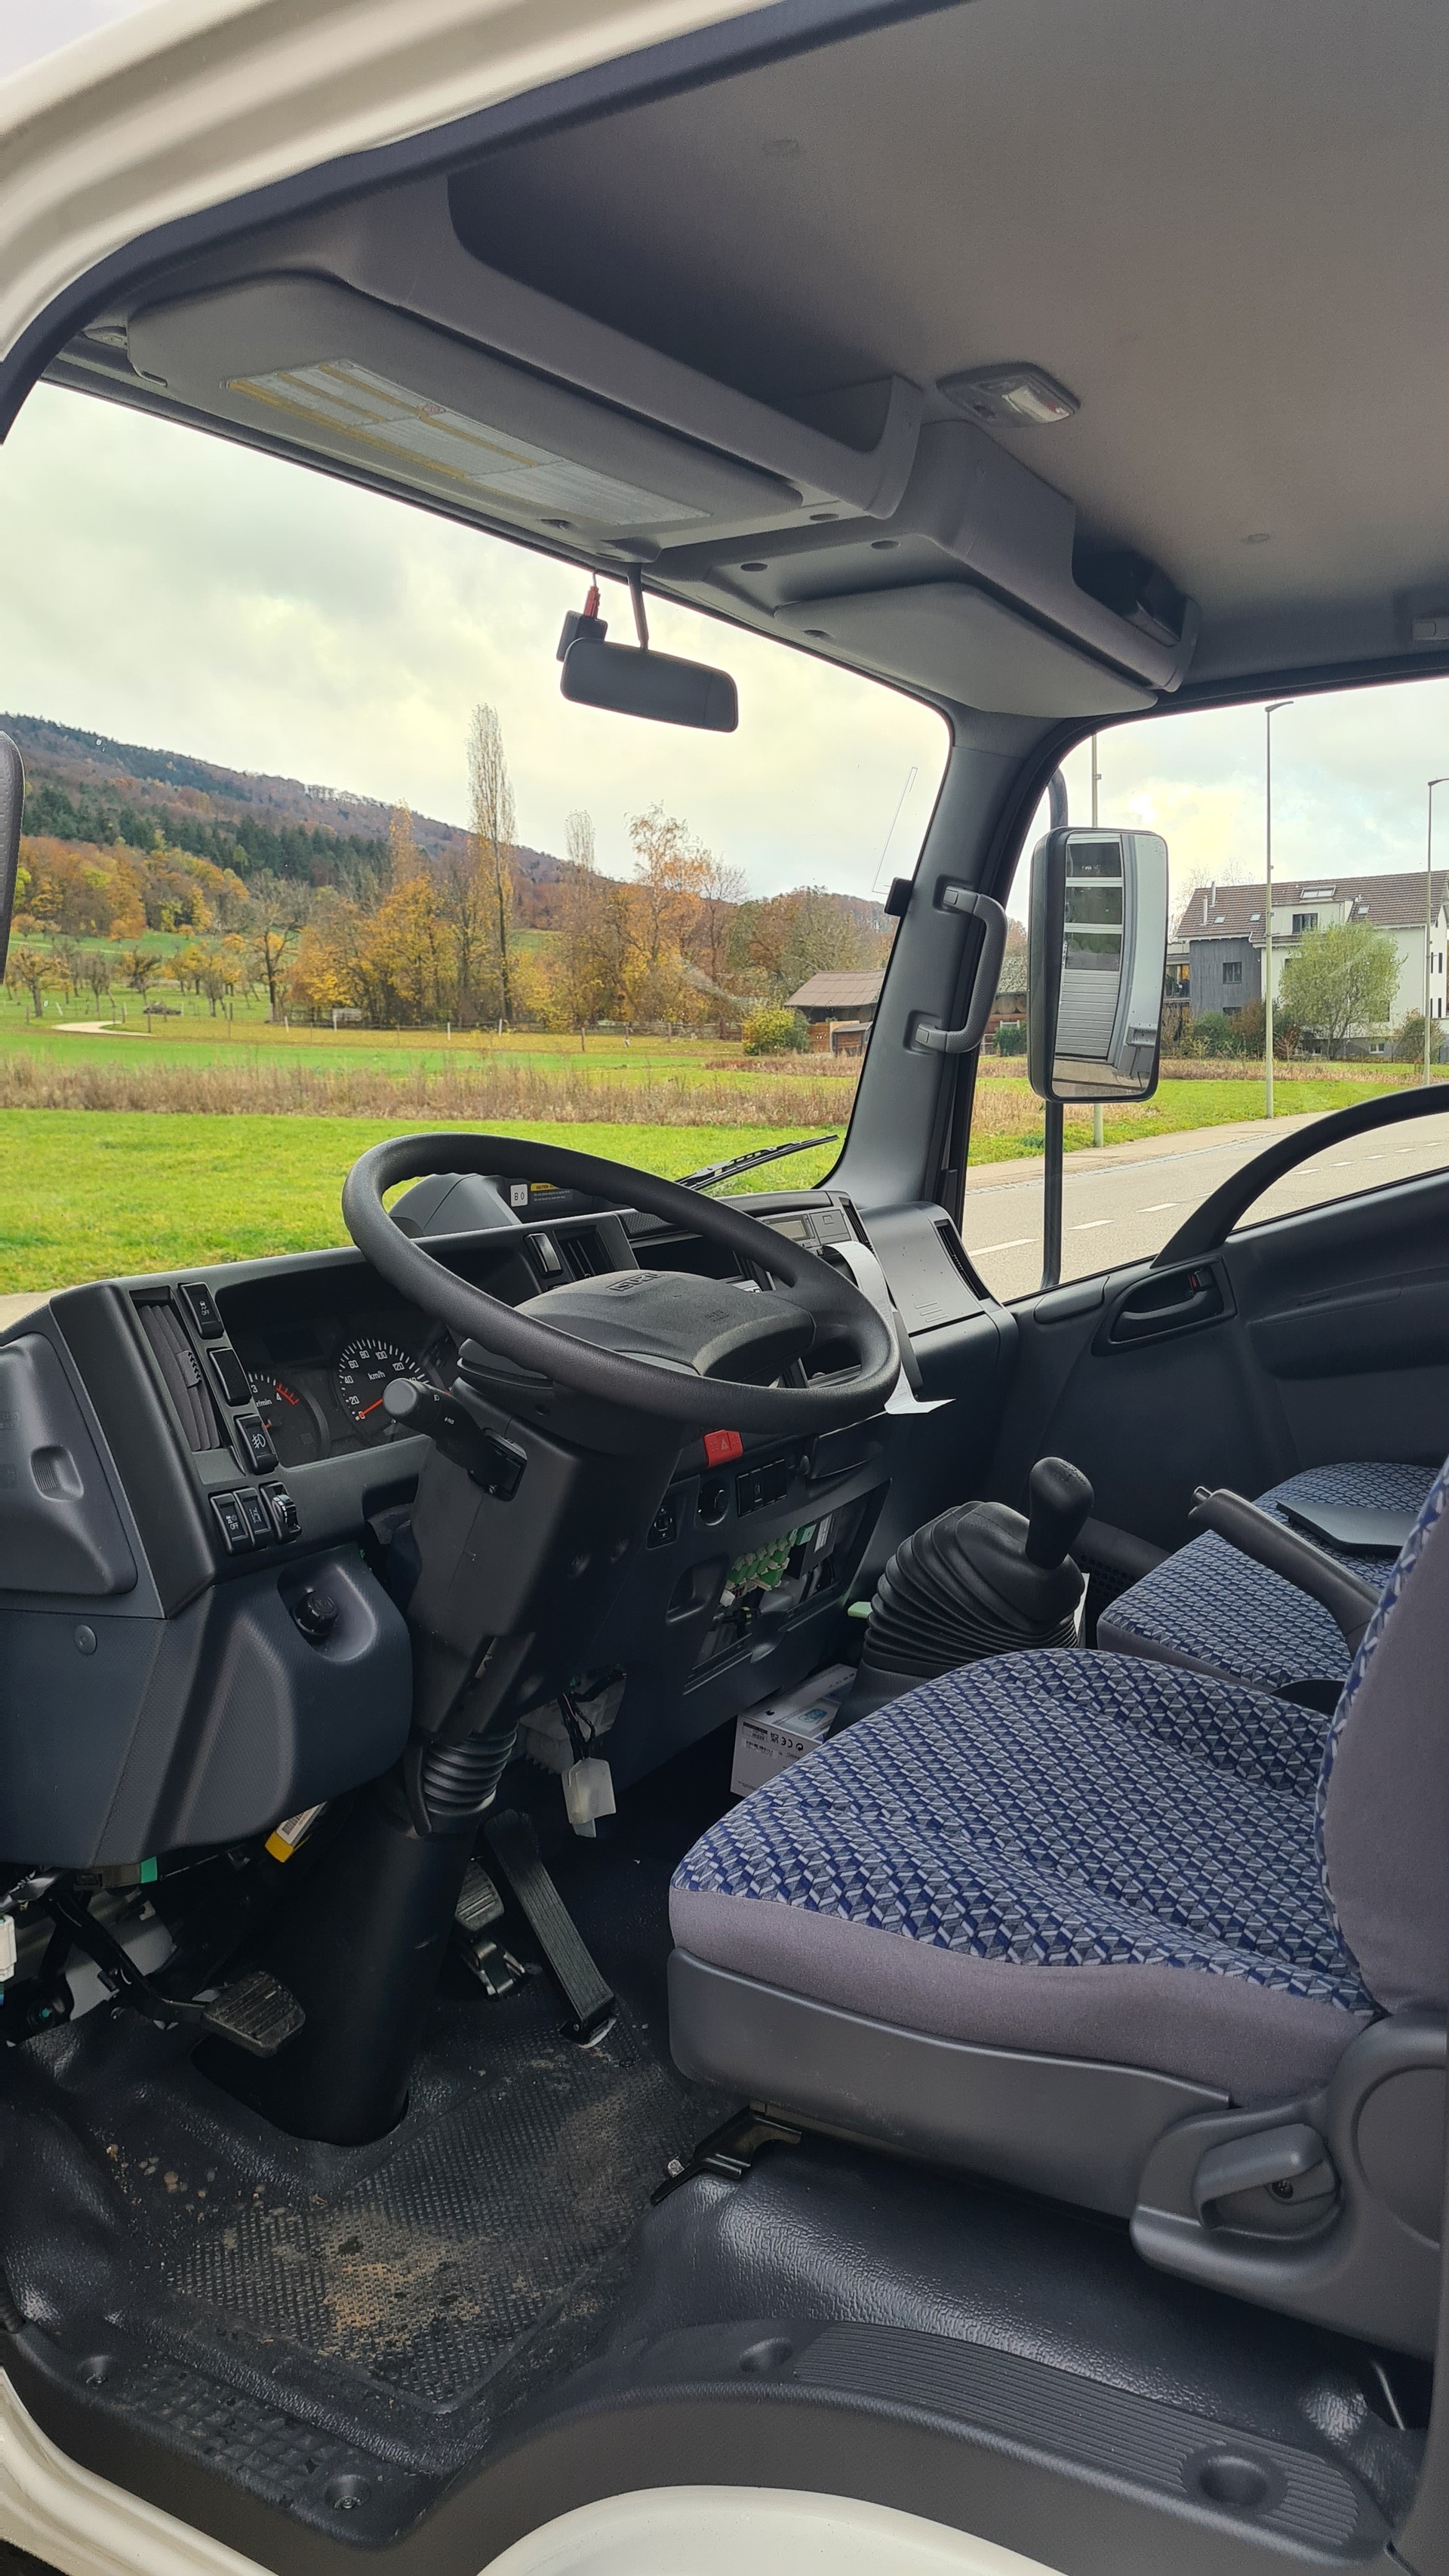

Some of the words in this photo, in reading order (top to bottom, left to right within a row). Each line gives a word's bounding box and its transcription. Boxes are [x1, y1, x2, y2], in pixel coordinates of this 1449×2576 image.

[359, 1350, 370, 1359] 80
[375, 1351, 388, 1360] 100
[348, 1360, 359, 1369] 60
[392, 1362, 405, 1371] 120
[344, 1375, 354, 1384] 40
[368, 1371, 386, 1380] km/h
[251, 1384, 258, 1393] 3
[276, 1393, 282, 1402] 4
[349, 1396, 360, 1405] 20
[229, 1522, 239, 1531] OFF
